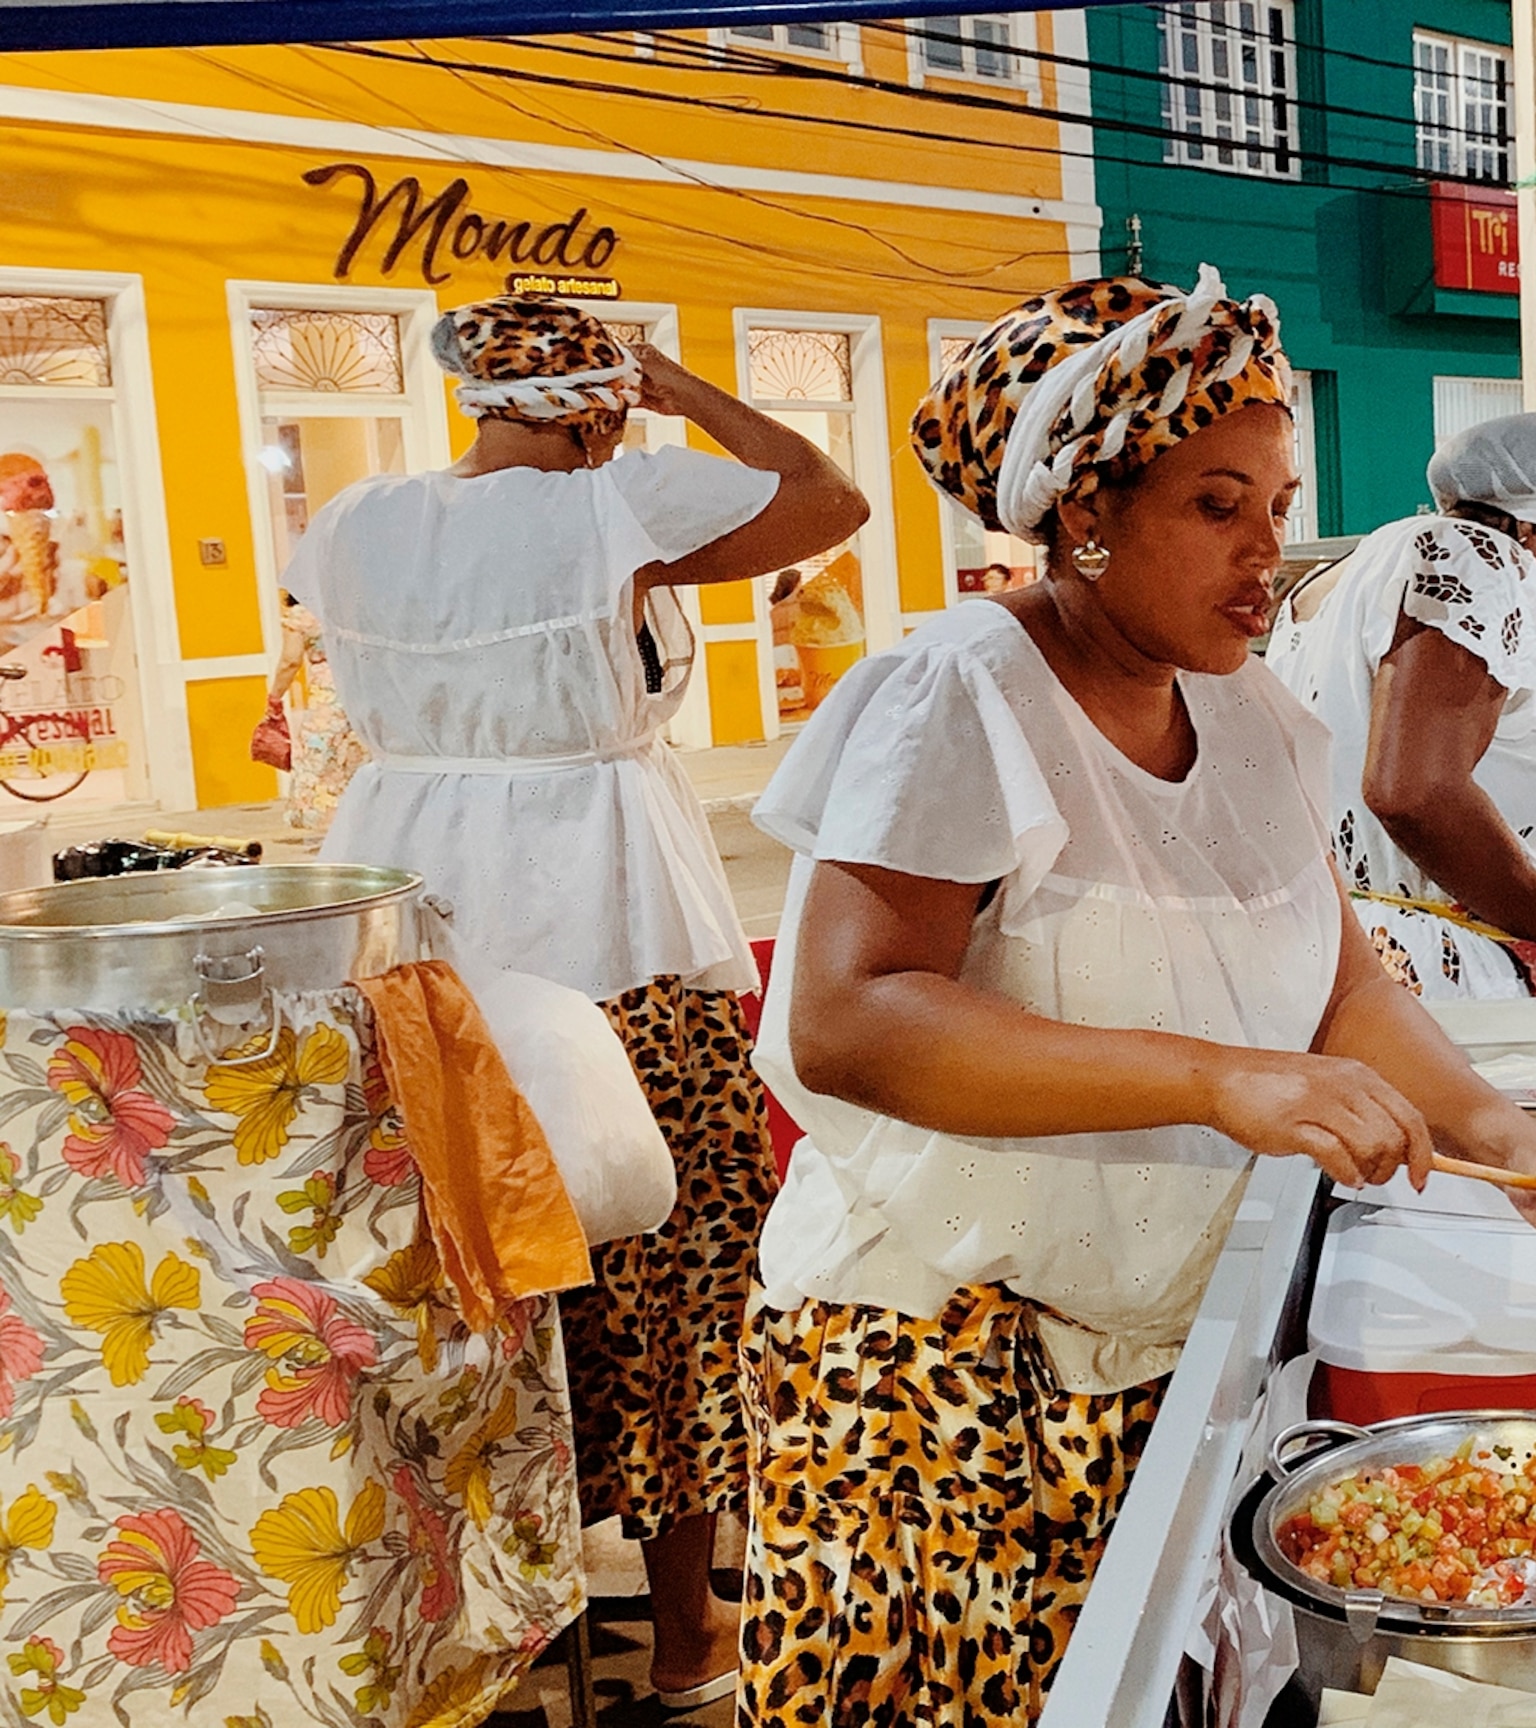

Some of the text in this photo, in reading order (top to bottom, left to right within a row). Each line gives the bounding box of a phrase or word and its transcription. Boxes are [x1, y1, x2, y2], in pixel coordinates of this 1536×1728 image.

[301, 163, 620, 285] Mondo
[1472, 210, 1509, 256] Tri
[513, 274, 619, 297] gelato artesanal
